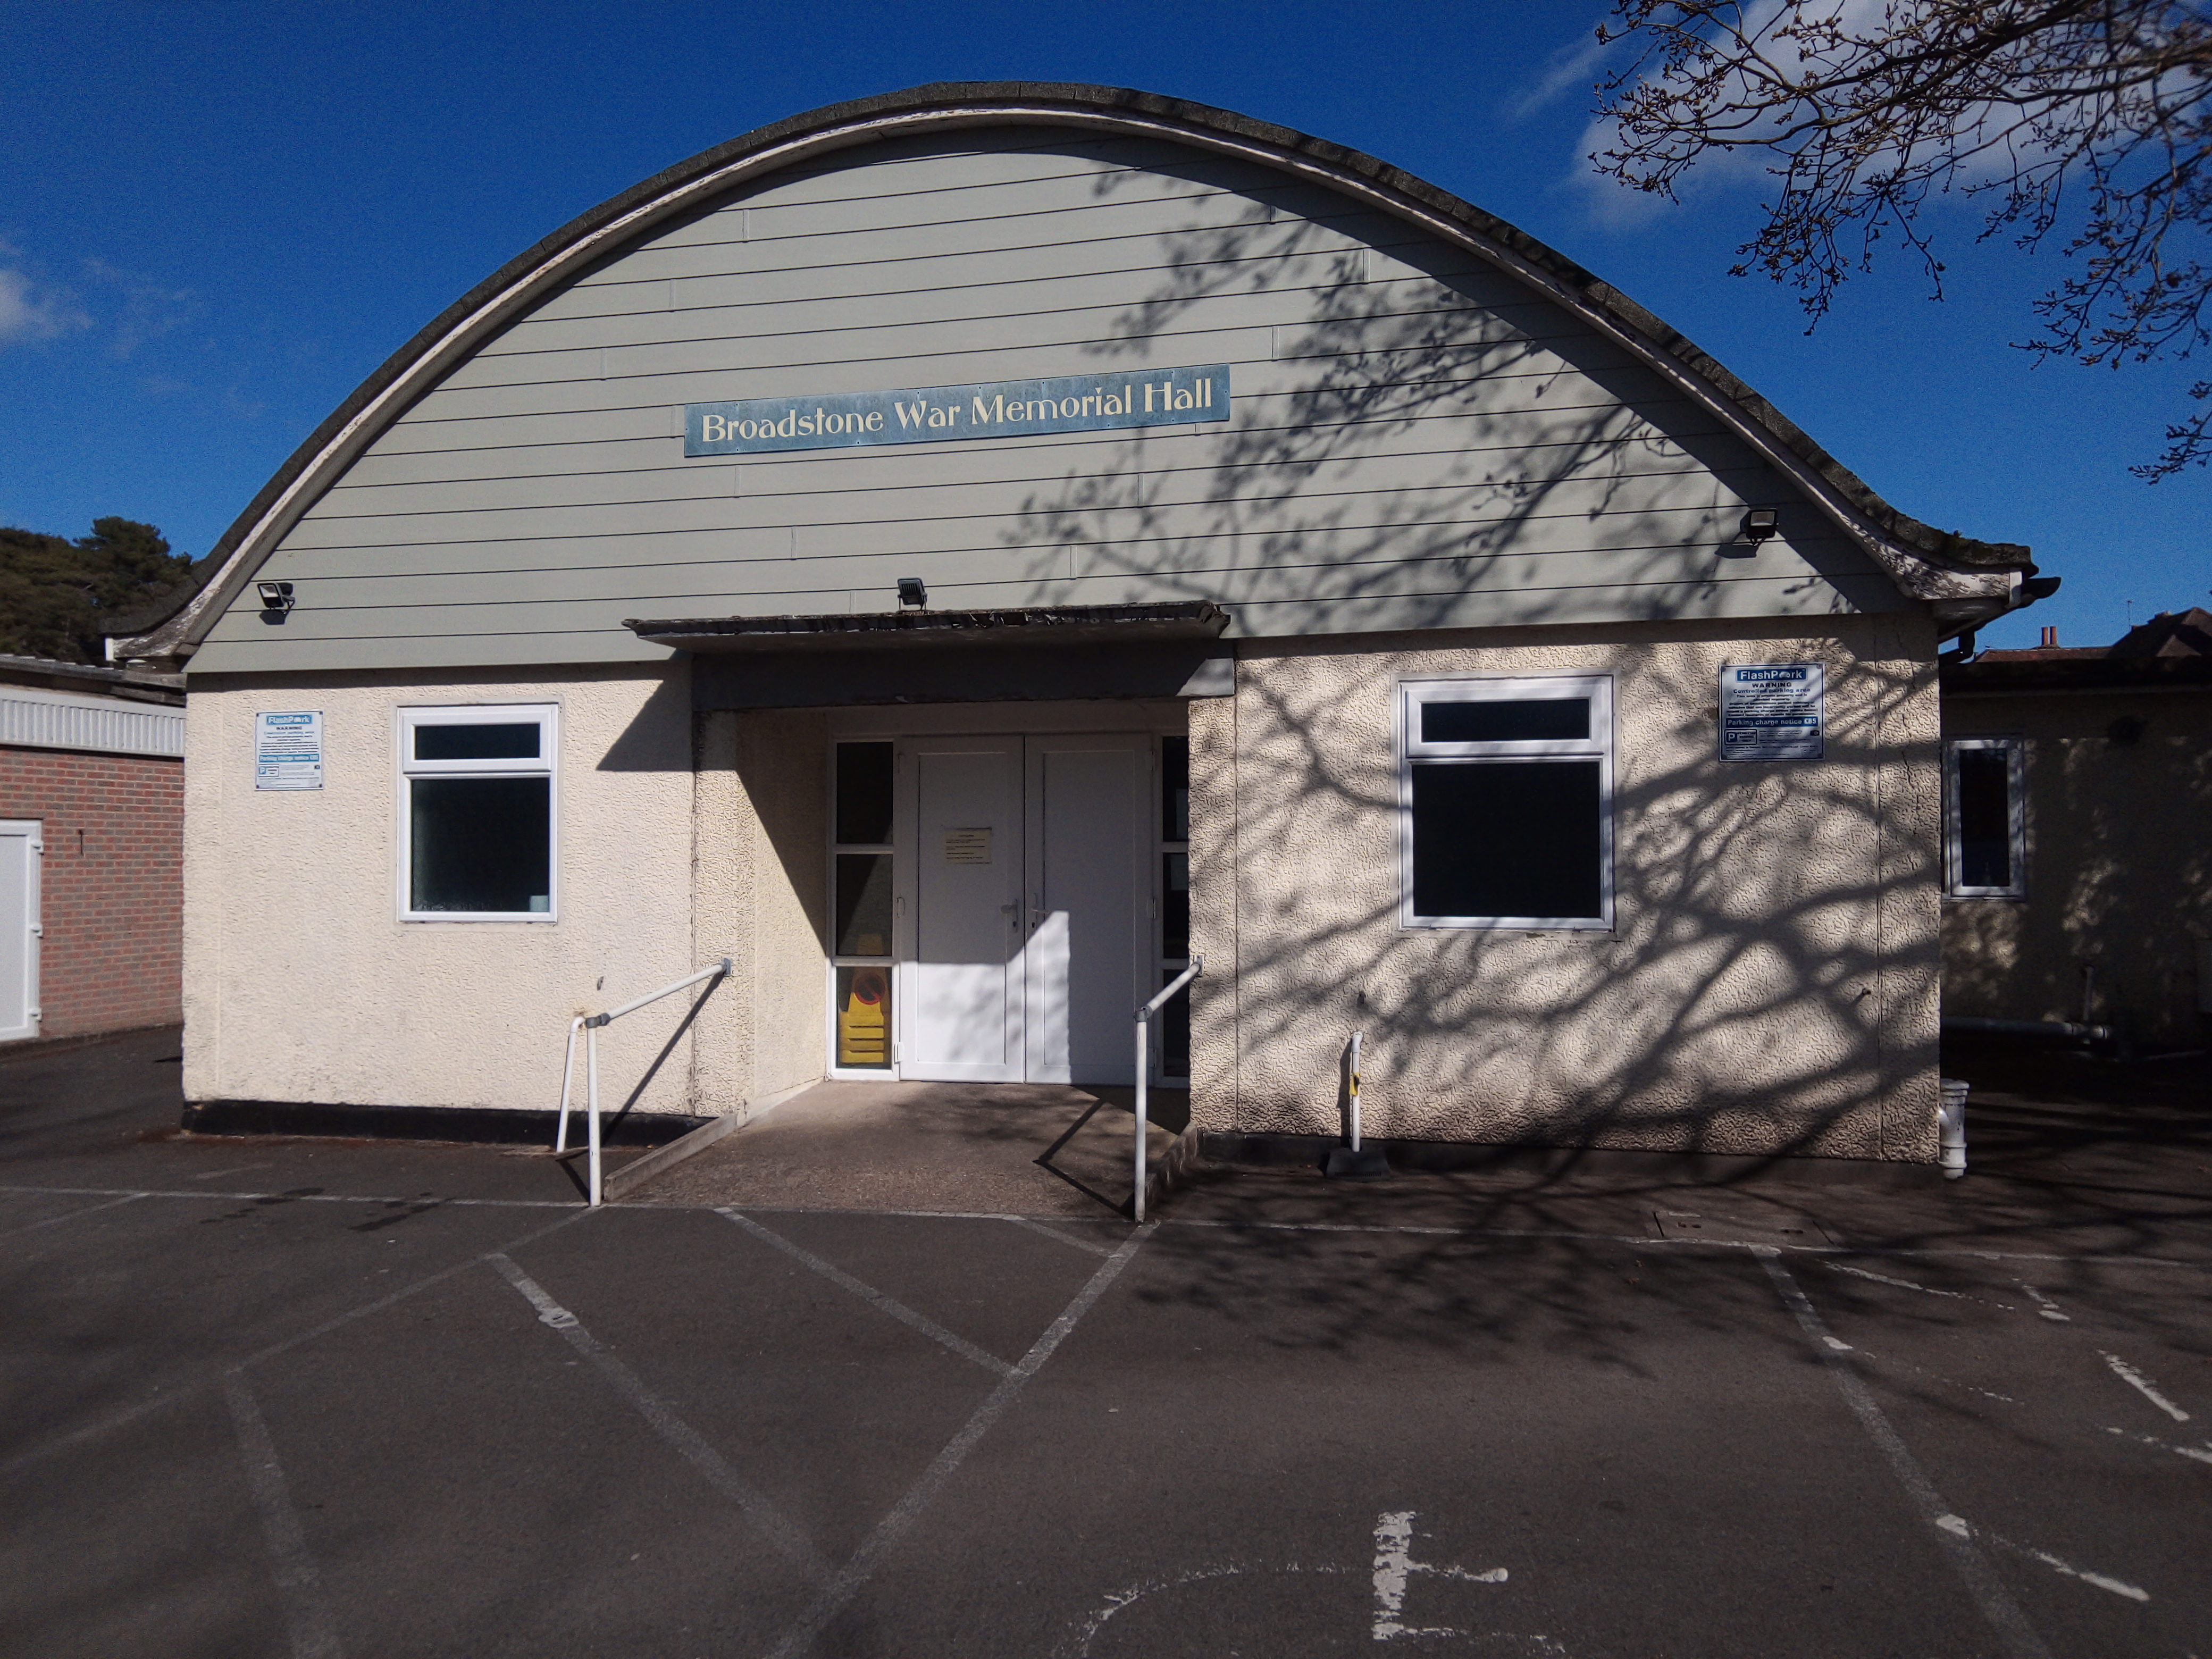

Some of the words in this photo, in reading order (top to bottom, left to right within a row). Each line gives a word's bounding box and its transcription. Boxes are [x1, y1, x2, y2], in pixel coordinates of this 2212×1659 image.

[702, 407, 884, 442] Broadstone
[894, 400, 961, 429] War
[971, 384, 1132, 425] Memorial
[1144, 378, 1212, 412] Hall
